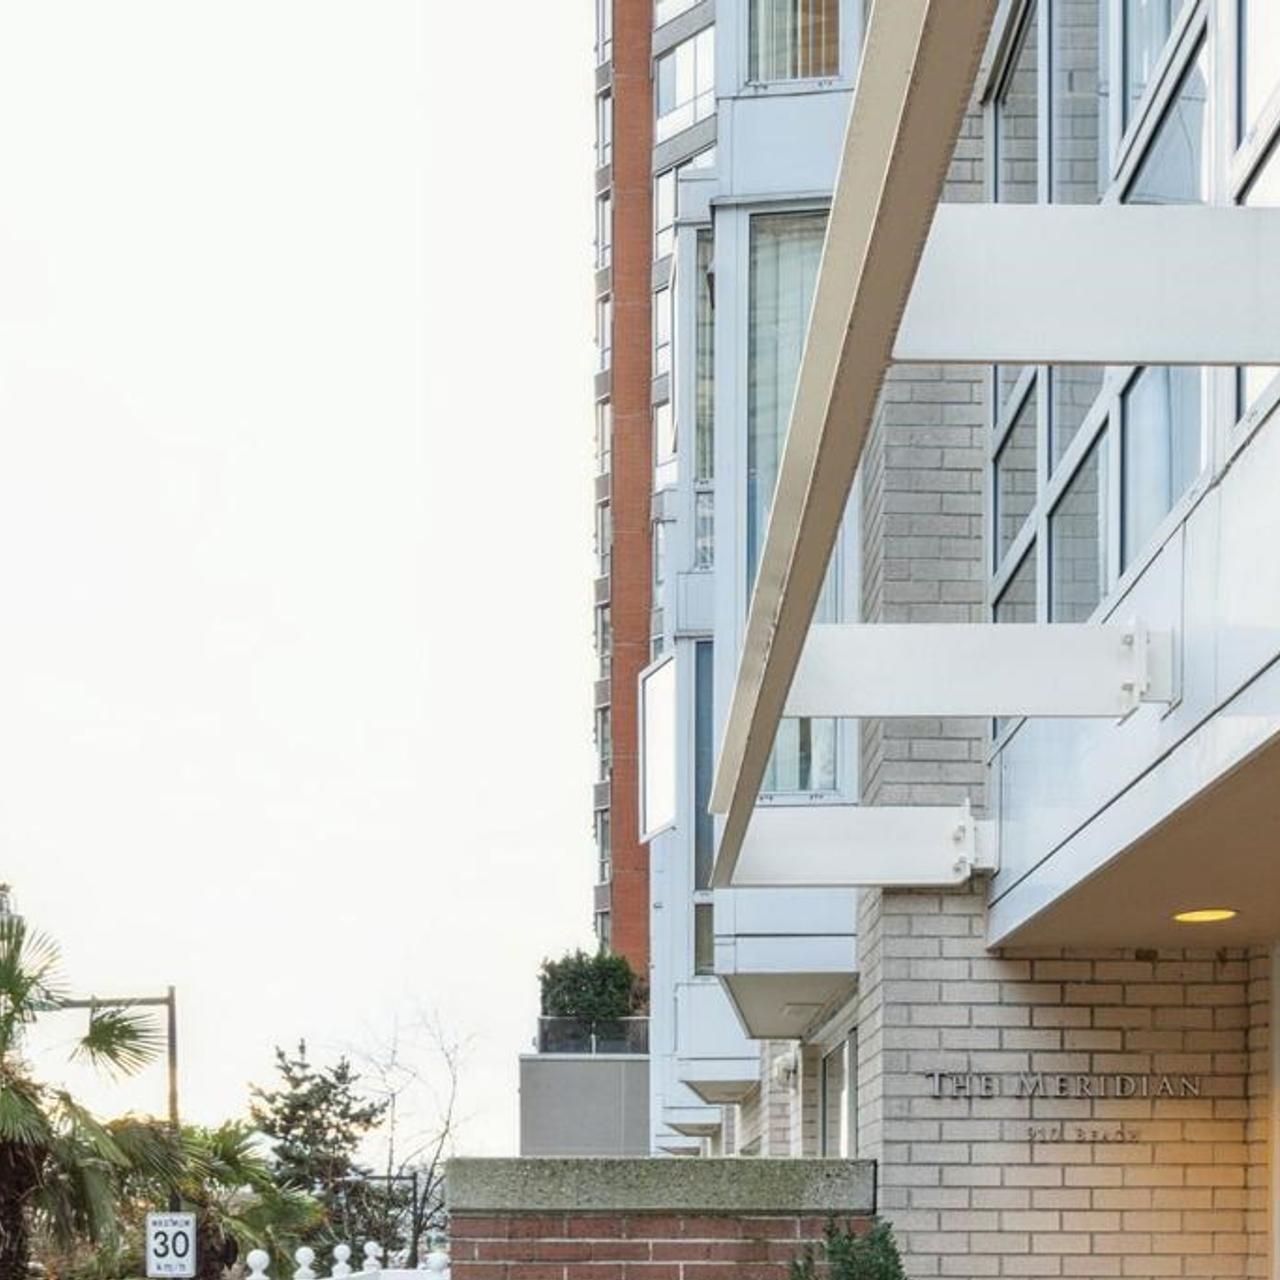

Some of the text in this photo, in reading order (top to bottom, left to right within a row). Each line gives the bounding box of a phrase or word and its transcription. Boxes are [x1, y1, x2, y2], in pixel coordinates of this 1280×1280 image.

[925, 1072, 1202, 1099] THE MERIDIAN
[153, 1230, 190, 1258] 30
